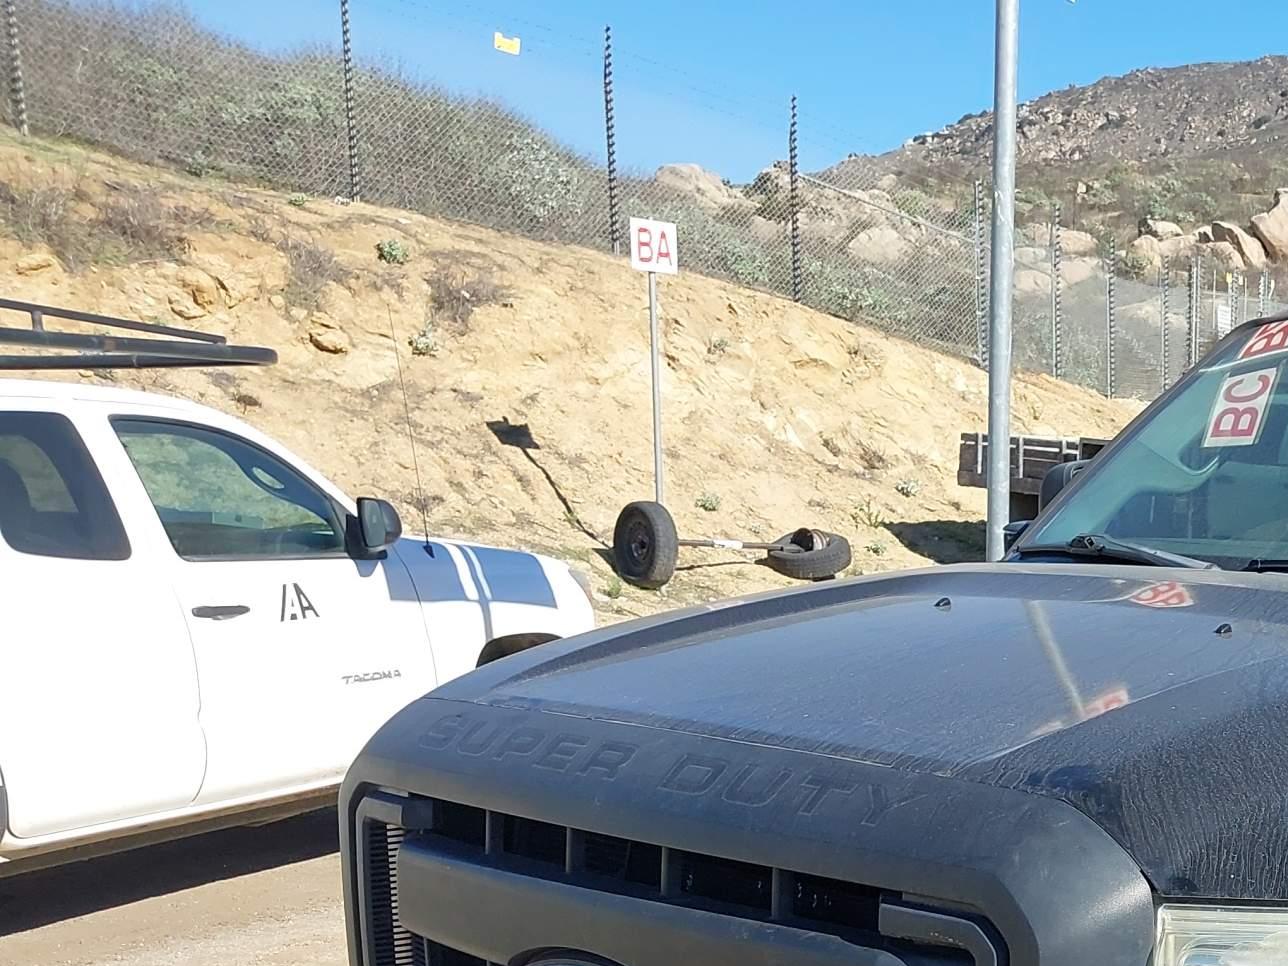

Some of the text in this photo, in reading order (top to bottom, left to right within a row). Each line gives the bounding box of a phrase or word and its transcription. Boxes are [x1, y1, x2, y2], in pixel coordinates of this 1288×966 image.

[638, 227, 673, 266] BA
[1210, 374, 1271, 438] BC
[341, 669, 402, 685] TACOMA
[418, 712, 927, 827] SUPER DUTY
